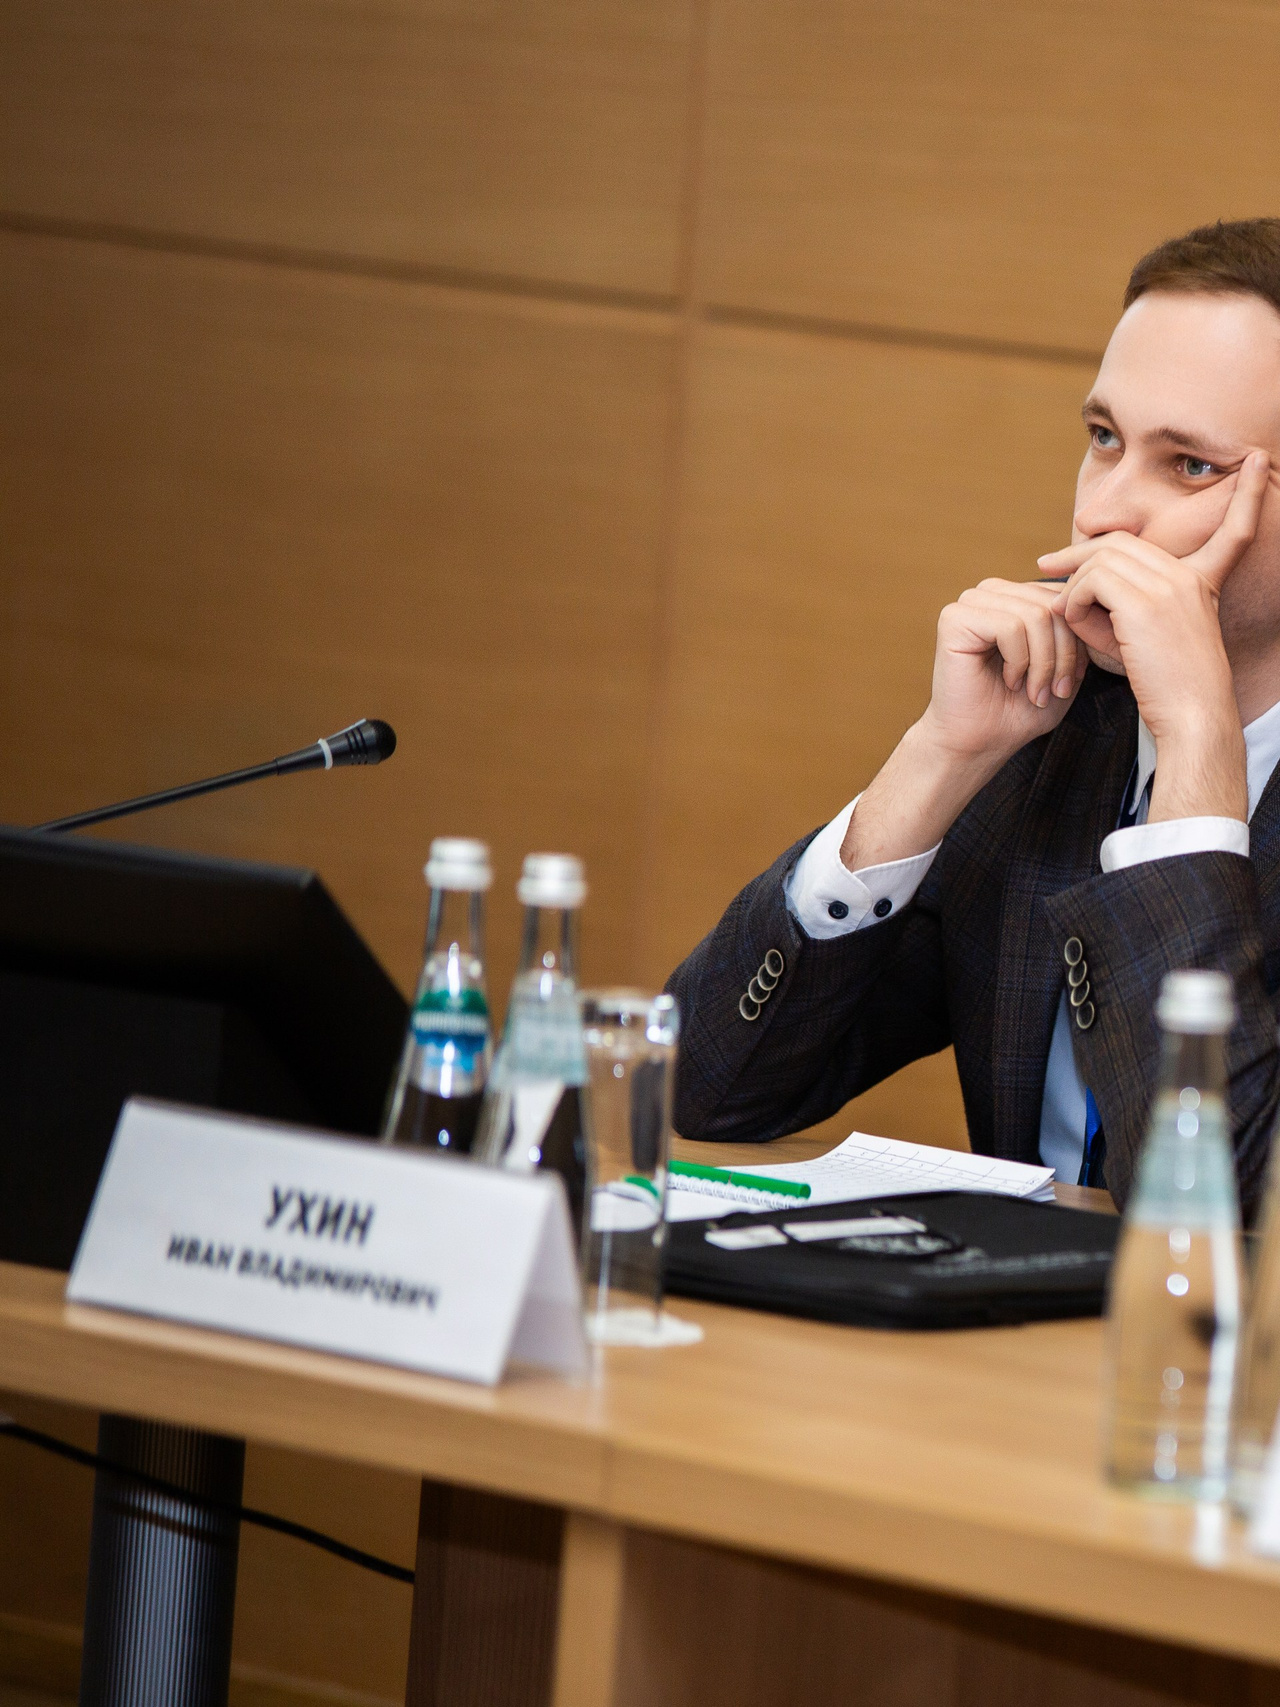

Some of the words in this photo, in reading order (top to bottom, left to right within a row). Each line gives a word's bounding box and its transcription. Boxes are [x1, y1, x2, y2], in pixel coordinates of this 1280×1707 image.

[265, 1185, 374, 1245] УХИН
[166, 1235, 235, 1271] ИВАН
[237, 1249, 438, 1311] ВЛАДИМИРОВИЧ
